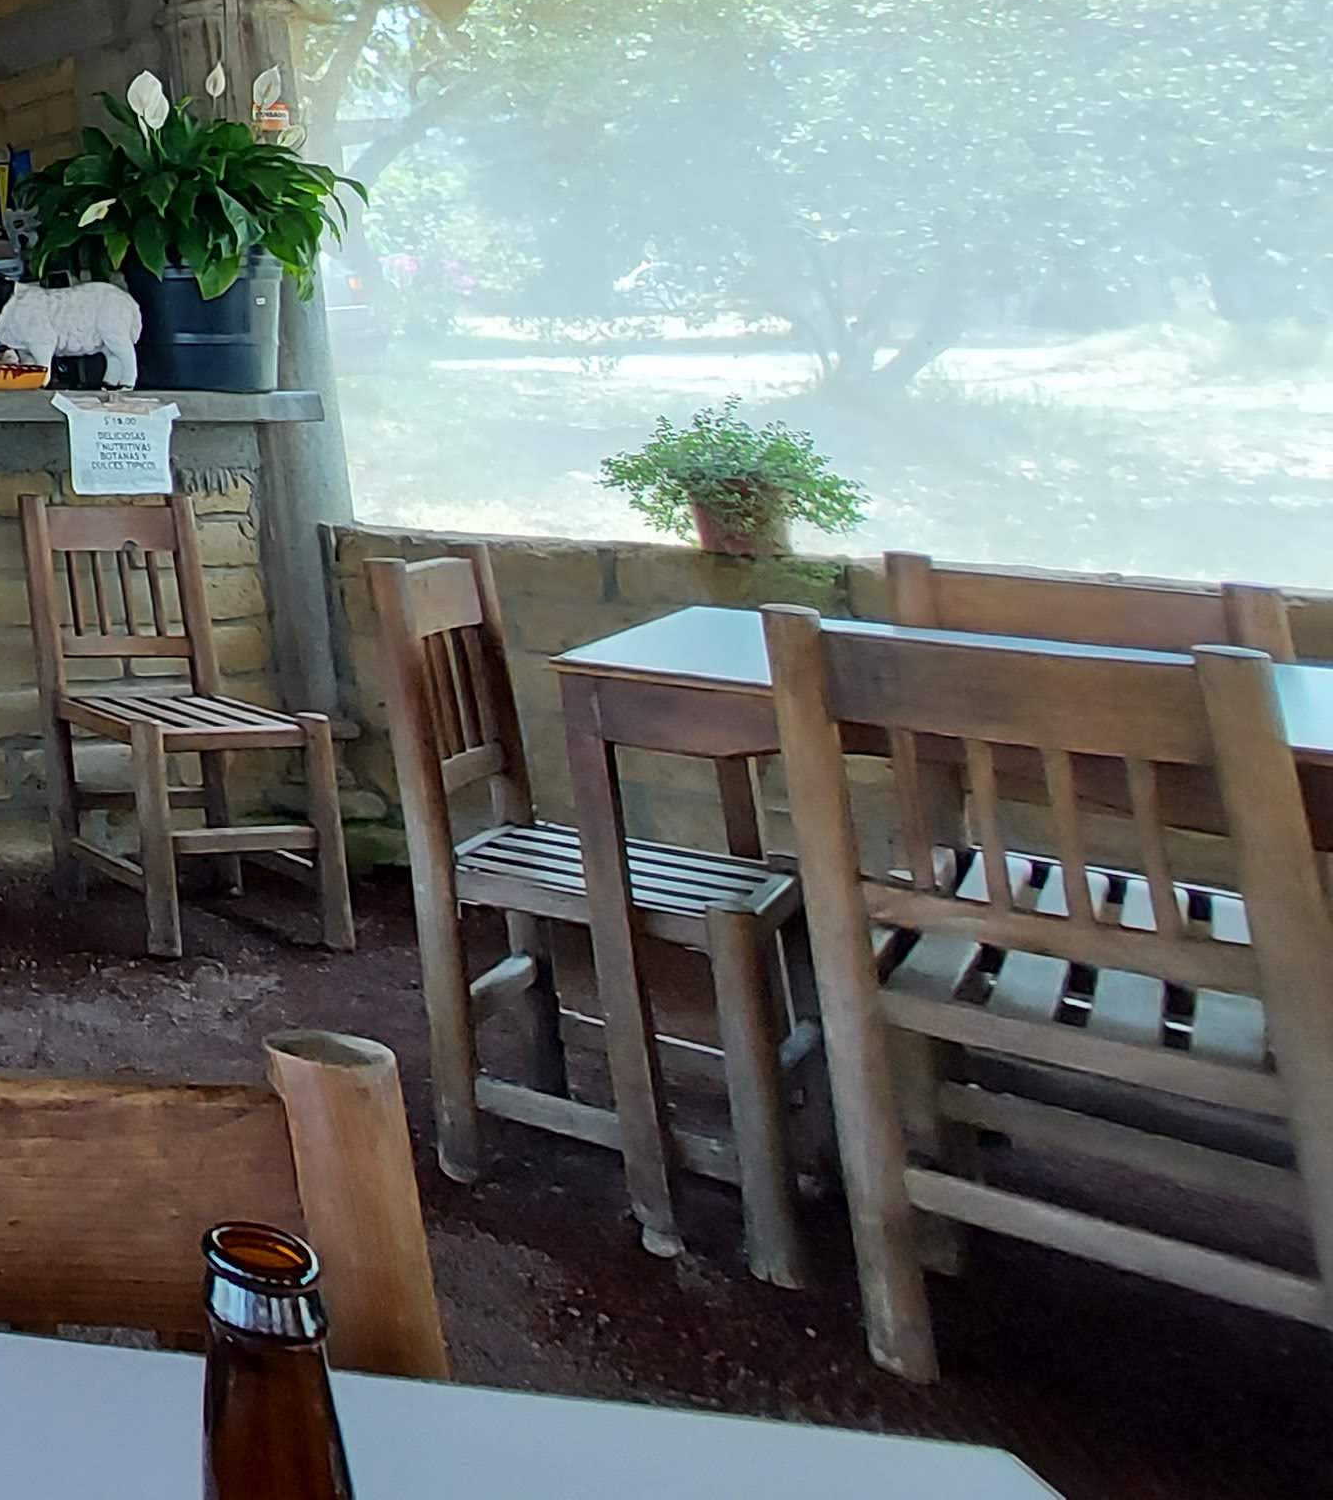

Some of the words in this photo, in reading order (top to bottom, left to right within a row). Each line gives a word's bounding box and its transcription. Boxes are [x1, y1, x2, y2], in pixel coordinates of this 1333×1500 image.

[97, 431, 146, 441] DELICIOSAS
[102, 442, 151, 452] NUTRITIVAS
[100, 451, 140, 461] BOTANAS
[91, 461, 124, 470] DULCES
